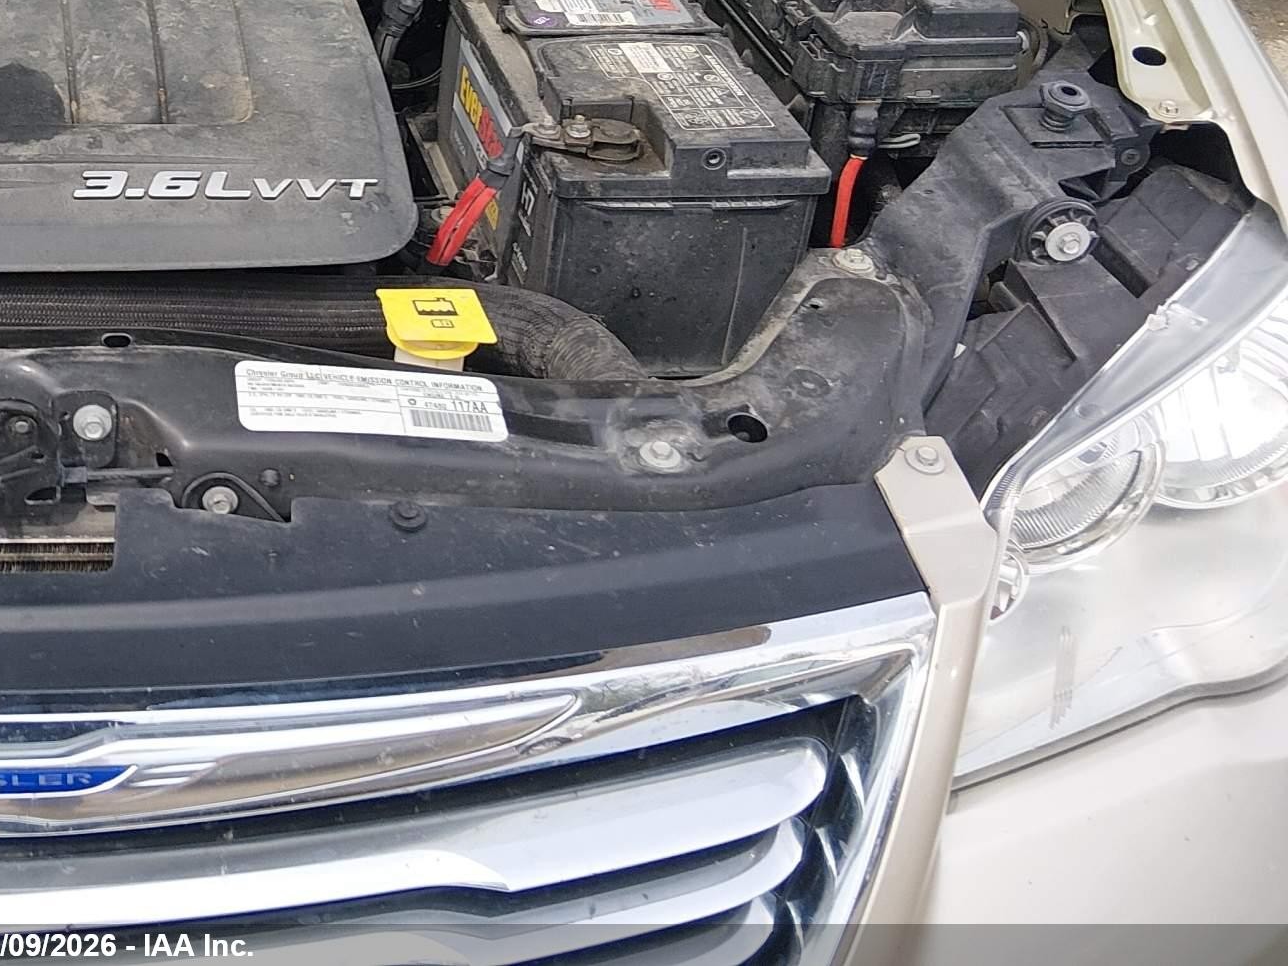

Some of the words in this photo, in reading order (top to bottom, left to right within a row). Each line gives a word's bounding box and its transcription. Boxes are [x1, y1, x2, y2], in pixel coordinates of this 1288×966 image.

[356, 375, 393, 385] EMISSION
[395, 378, 429, 387] CONTROL
[431, 380, 483, 392] INFORMATION
